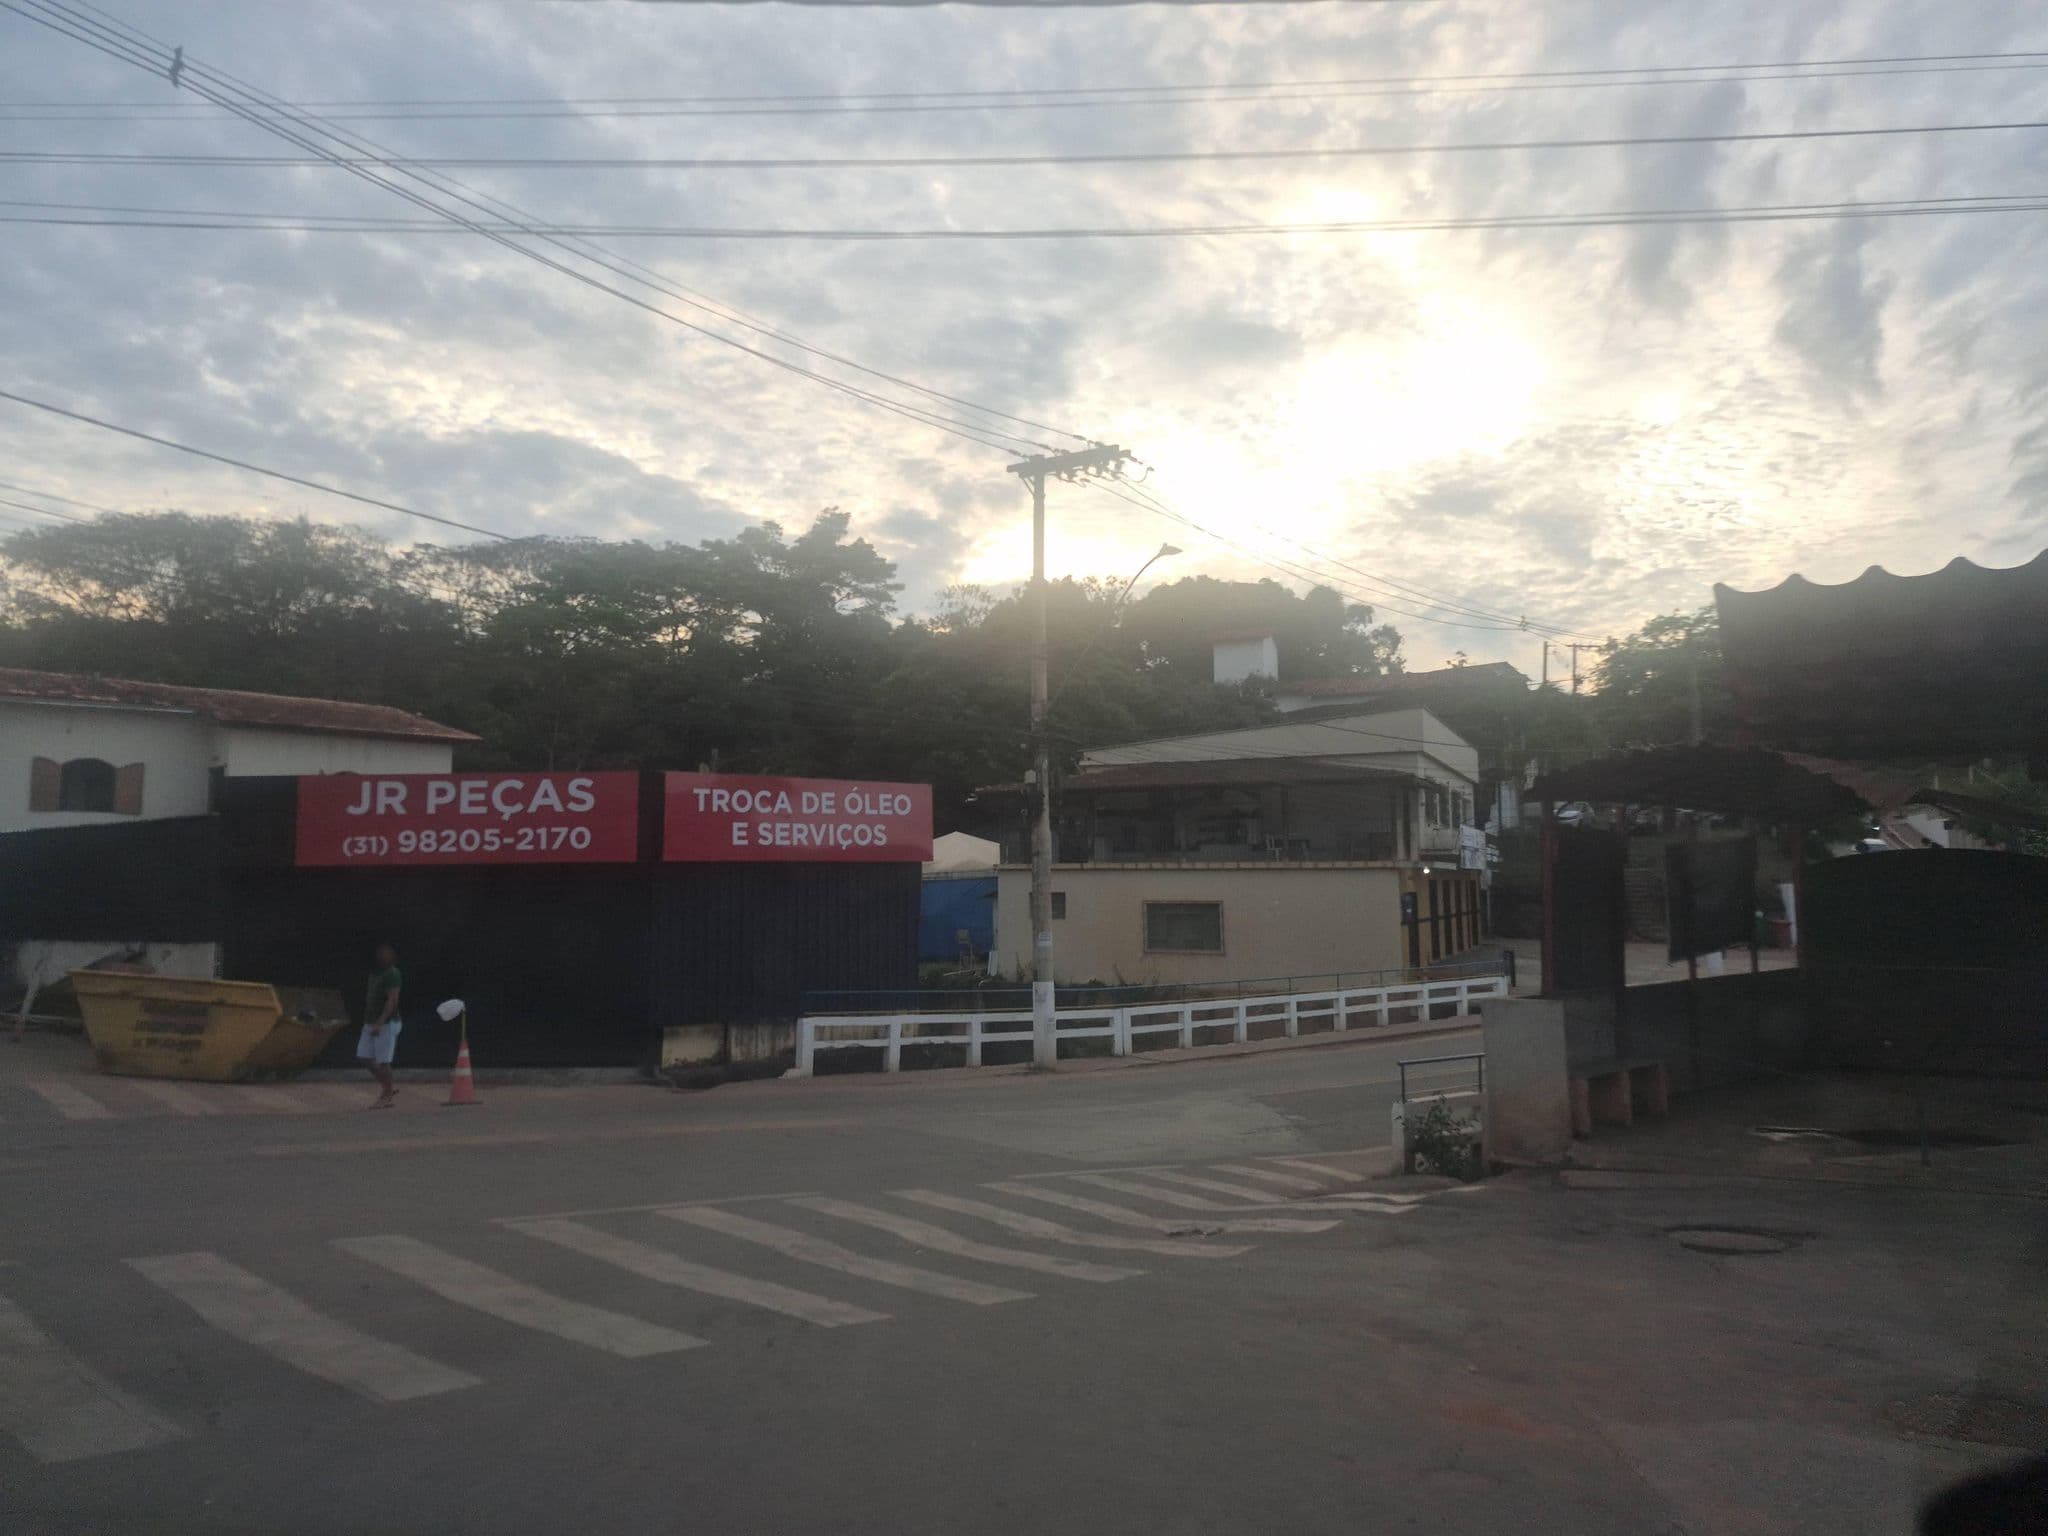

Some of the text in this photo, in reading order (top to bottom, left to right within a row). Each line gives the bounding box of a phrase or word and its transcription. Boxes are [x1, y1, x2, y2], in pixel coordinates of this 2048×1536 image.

[346, 777, 596, 821] JR PEÇAS
[692, 785, 912, 817] TROCA DE ÓLEO
[342, 826, 592, 856] (31) 98205-2170
[732, 821, 888, 850] E SERVIÇOS
